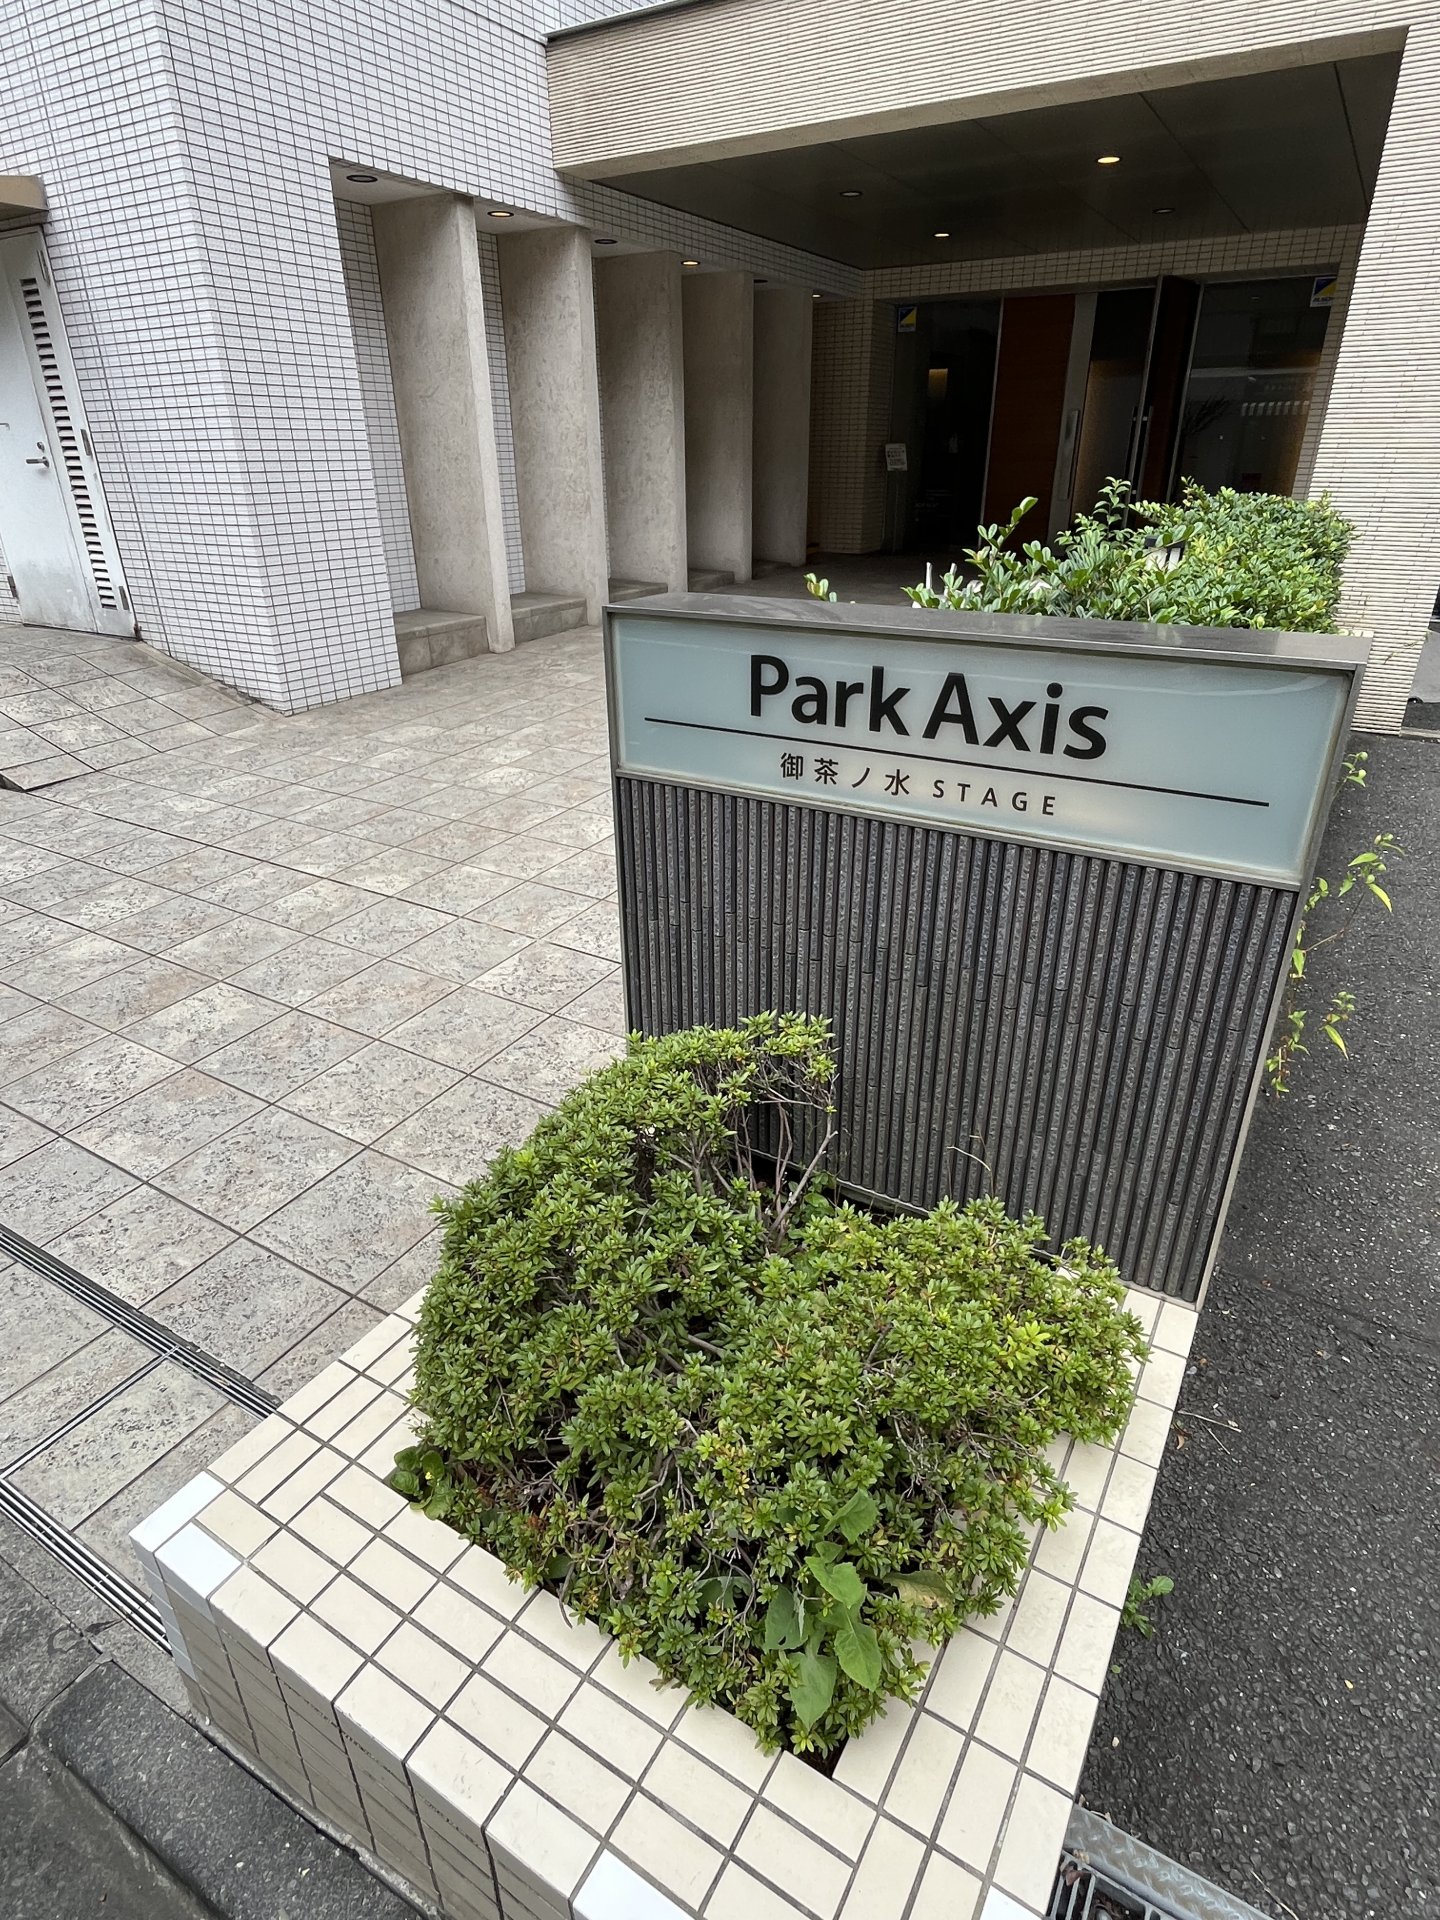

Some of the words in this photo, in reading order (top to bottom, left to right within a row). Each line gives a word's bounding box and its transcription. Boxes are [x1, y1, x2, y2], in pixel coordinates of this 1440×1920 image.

[750, 654, 911, 737] Park
[921, 671, 1110, 761] Axis
[779, 752, 911, 797] 御茶ノ水
[932, 779, 1057, 816] STAGE
